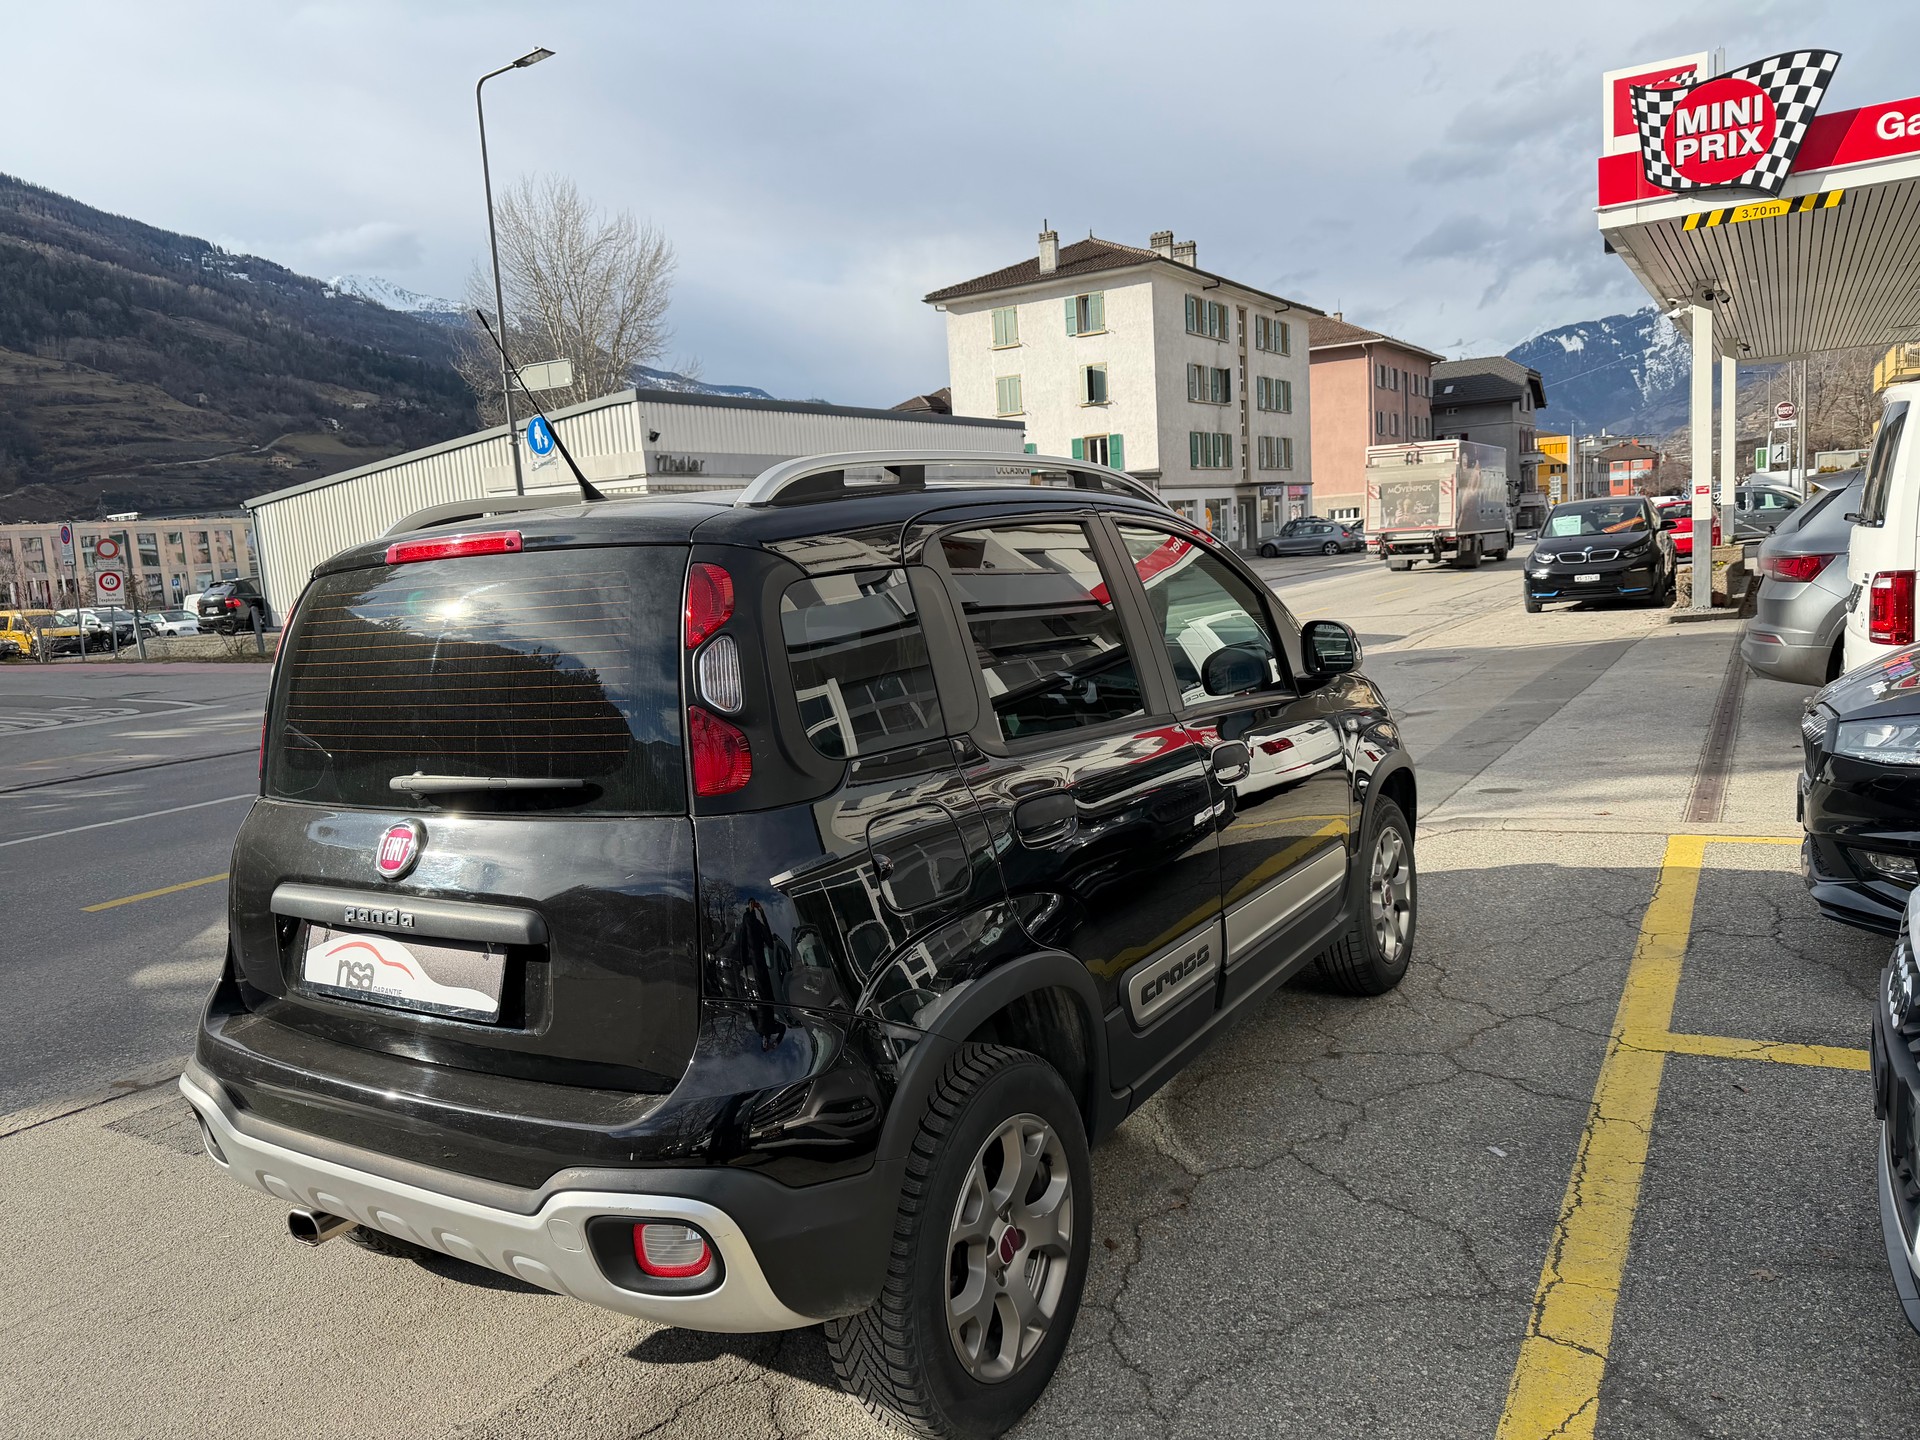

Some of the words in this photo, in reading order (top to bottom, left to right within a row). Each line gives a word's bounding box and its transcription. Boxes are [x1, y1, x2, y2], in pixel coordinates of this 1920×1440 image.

[1675, 94, 1763, 137] MINI
[1675, 125, 1764, 168] PRIX
[1741, 207, 1767, 219] 3.70
[1768, 205, 1780, 215] m
[382, 836, 410, 862] FIAT
[344, 906, 415, 928] panda
[336, 959, 375, 991] nsa
[1141, 944, 1210, 1006] cross
[372, 985, 403, 996] GARANTIE
